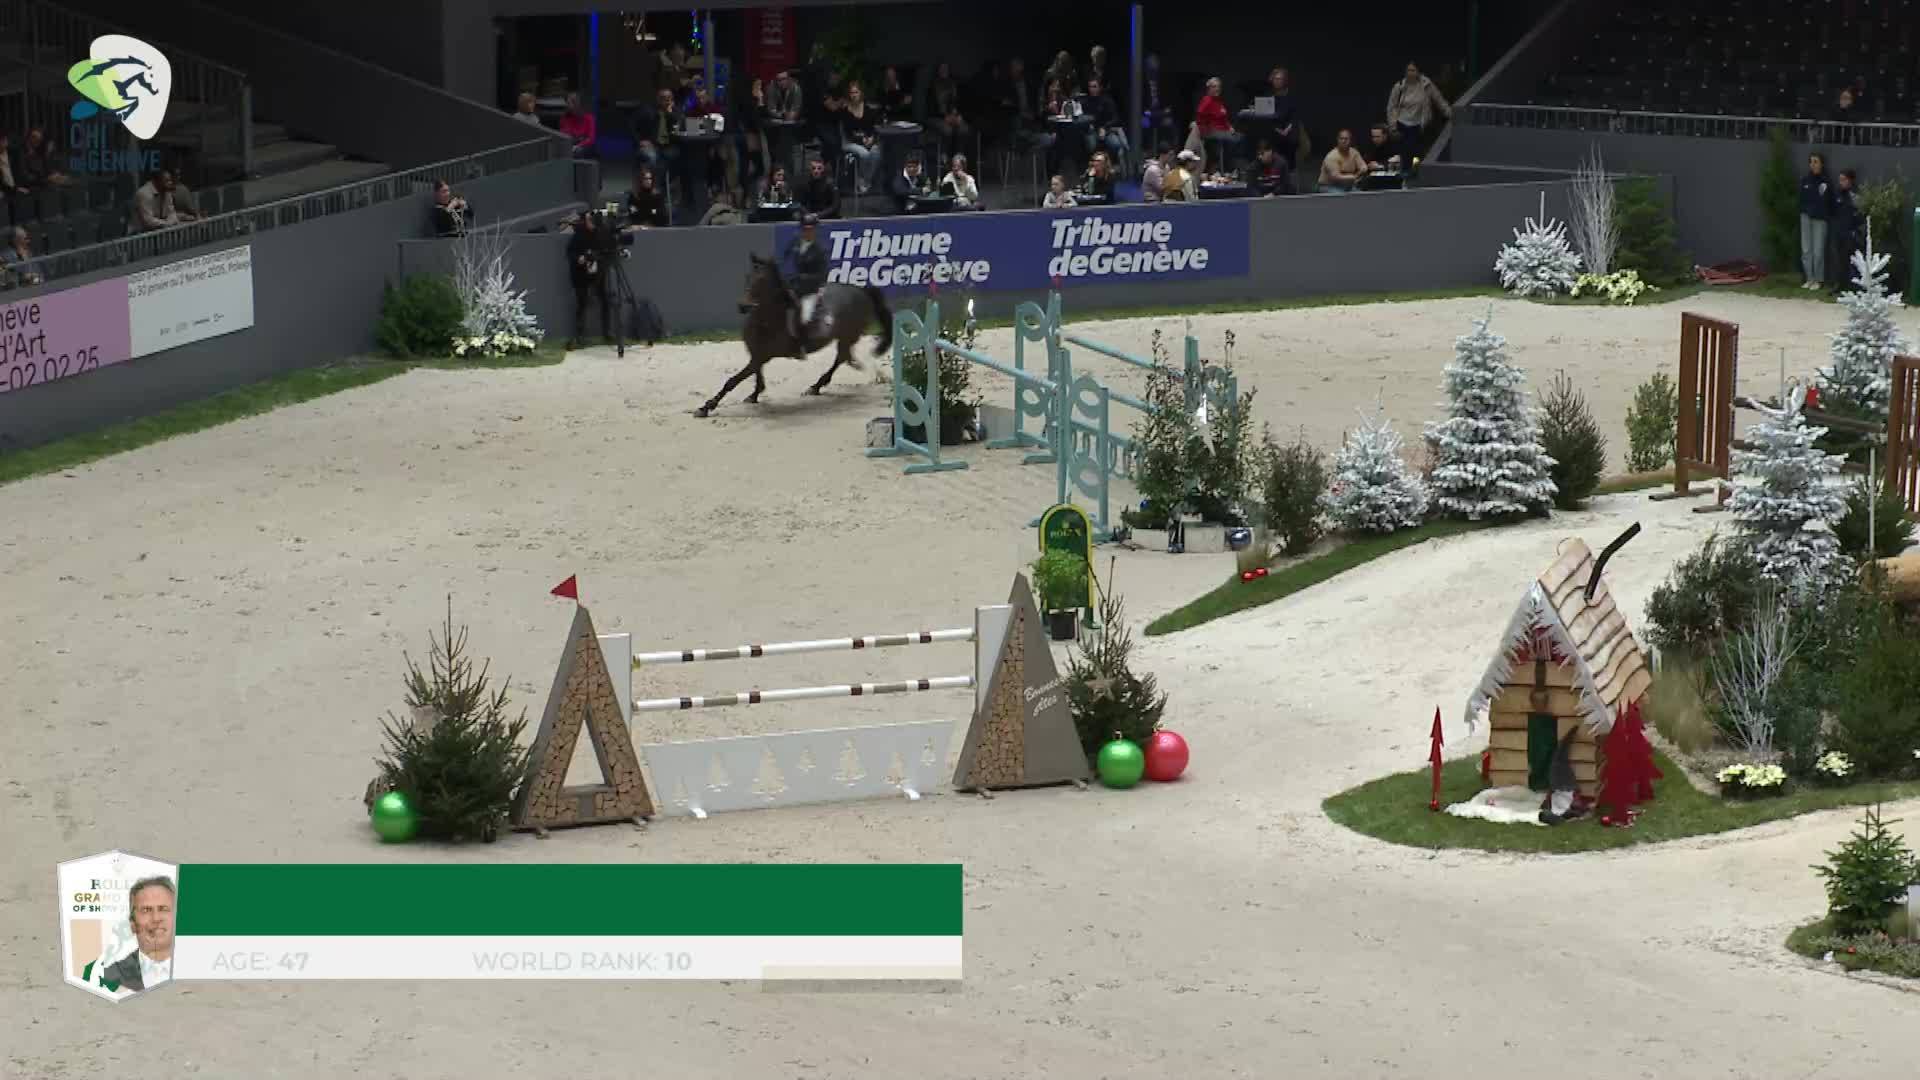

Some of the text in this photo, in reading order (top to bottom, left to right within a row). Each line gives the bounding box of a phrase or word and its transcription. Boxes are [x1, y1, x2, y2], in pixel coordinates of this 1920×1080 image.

[830, 229, 952, 260] Tribune
[1051, 217, 1173, 248] Tribune
[827, 254, 991, 287] deGenève
[1048, 243, 1209, 277] deGenève
